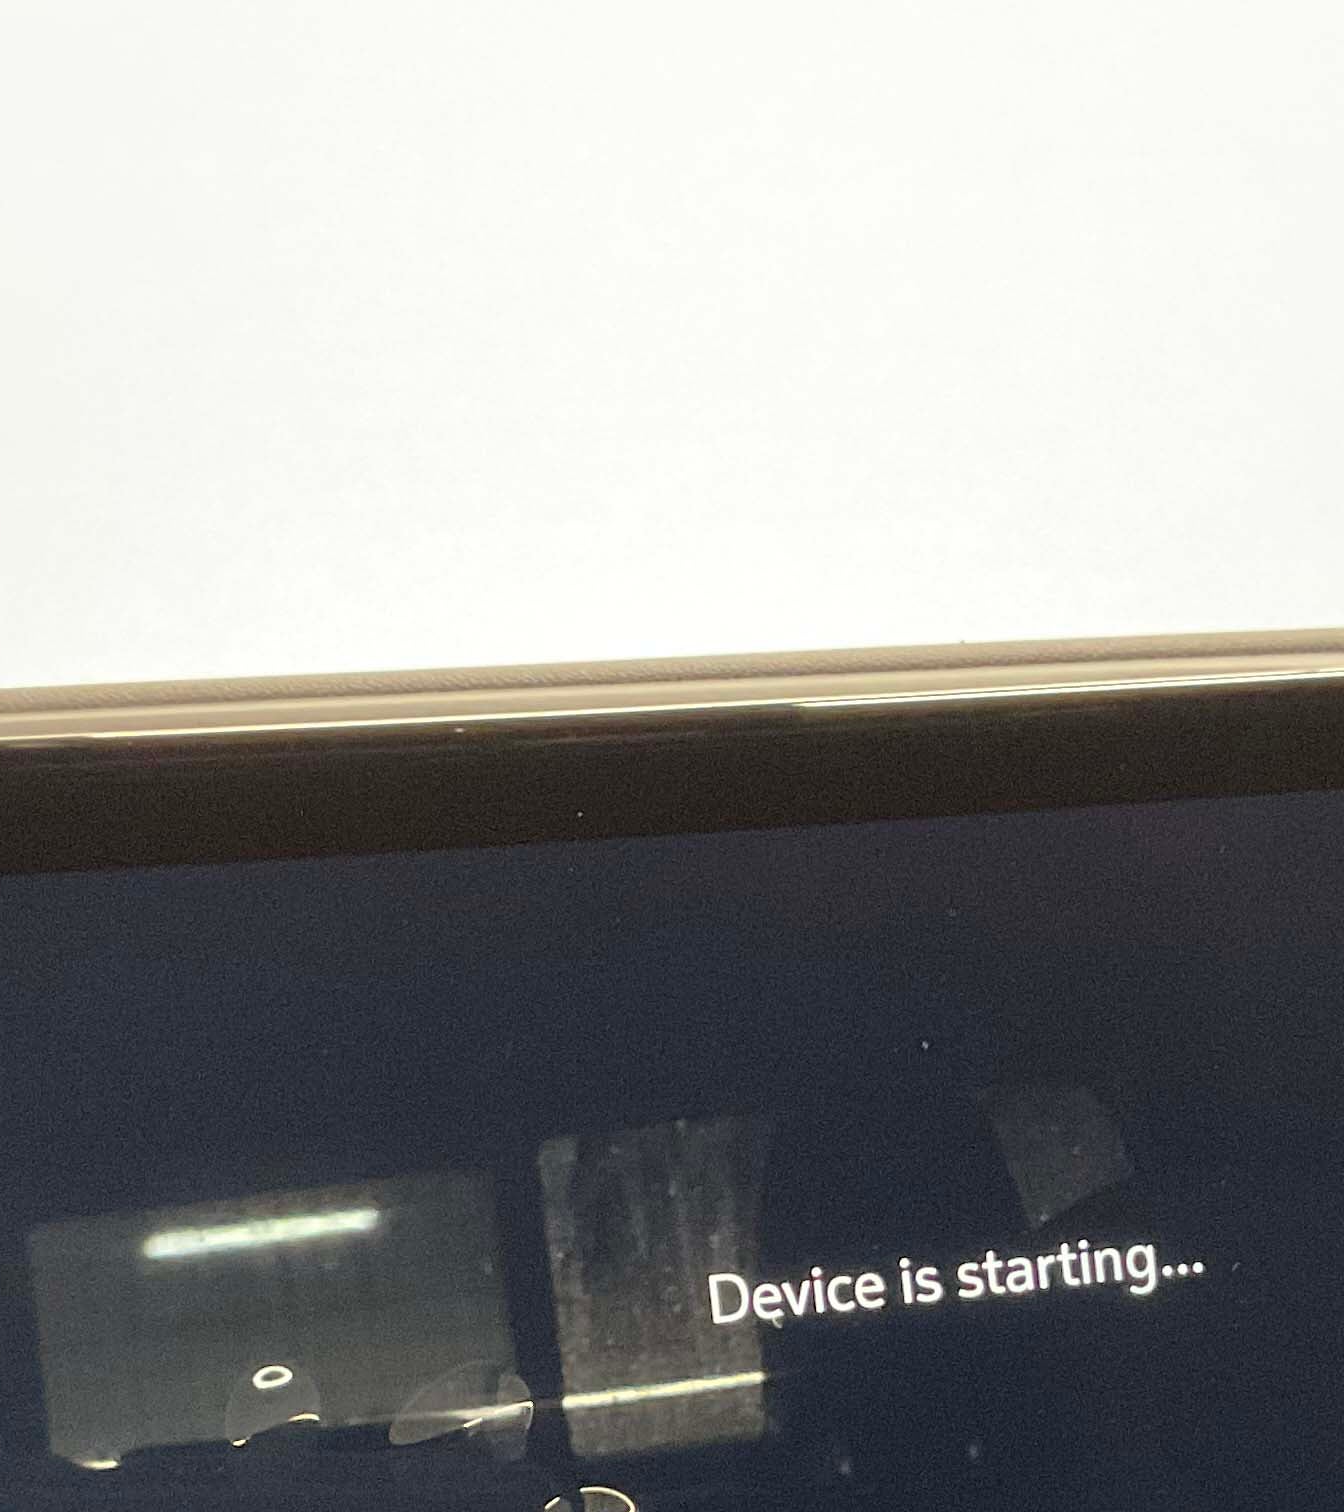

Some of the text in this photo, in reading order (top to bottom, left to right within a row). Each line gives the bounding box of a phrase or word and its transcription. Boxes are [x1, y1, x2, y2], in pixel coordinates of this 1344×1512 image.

[708, 1238, 1205, 1325] Device is starting...
